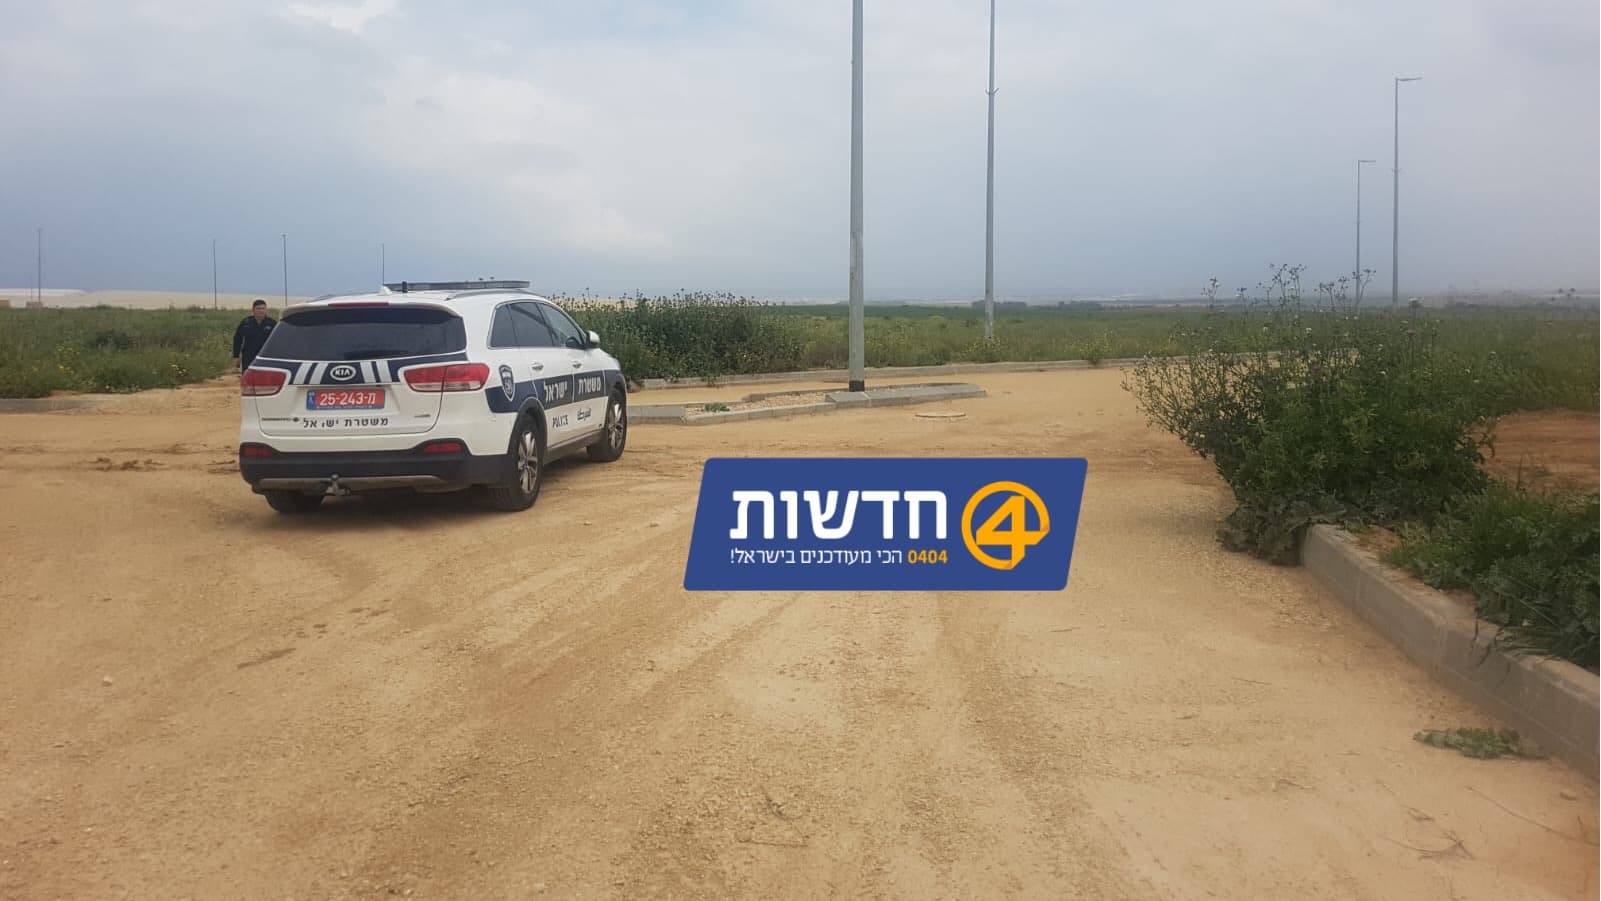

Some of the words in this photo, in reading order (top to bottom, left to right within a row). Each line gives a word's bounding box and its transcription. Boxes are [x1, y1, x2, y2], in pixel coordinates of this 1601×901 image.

[334, 368, 352, 377] KIA
[543, 379, 568, 403] ישראל
[344, 417, 389, 427] משטרת
